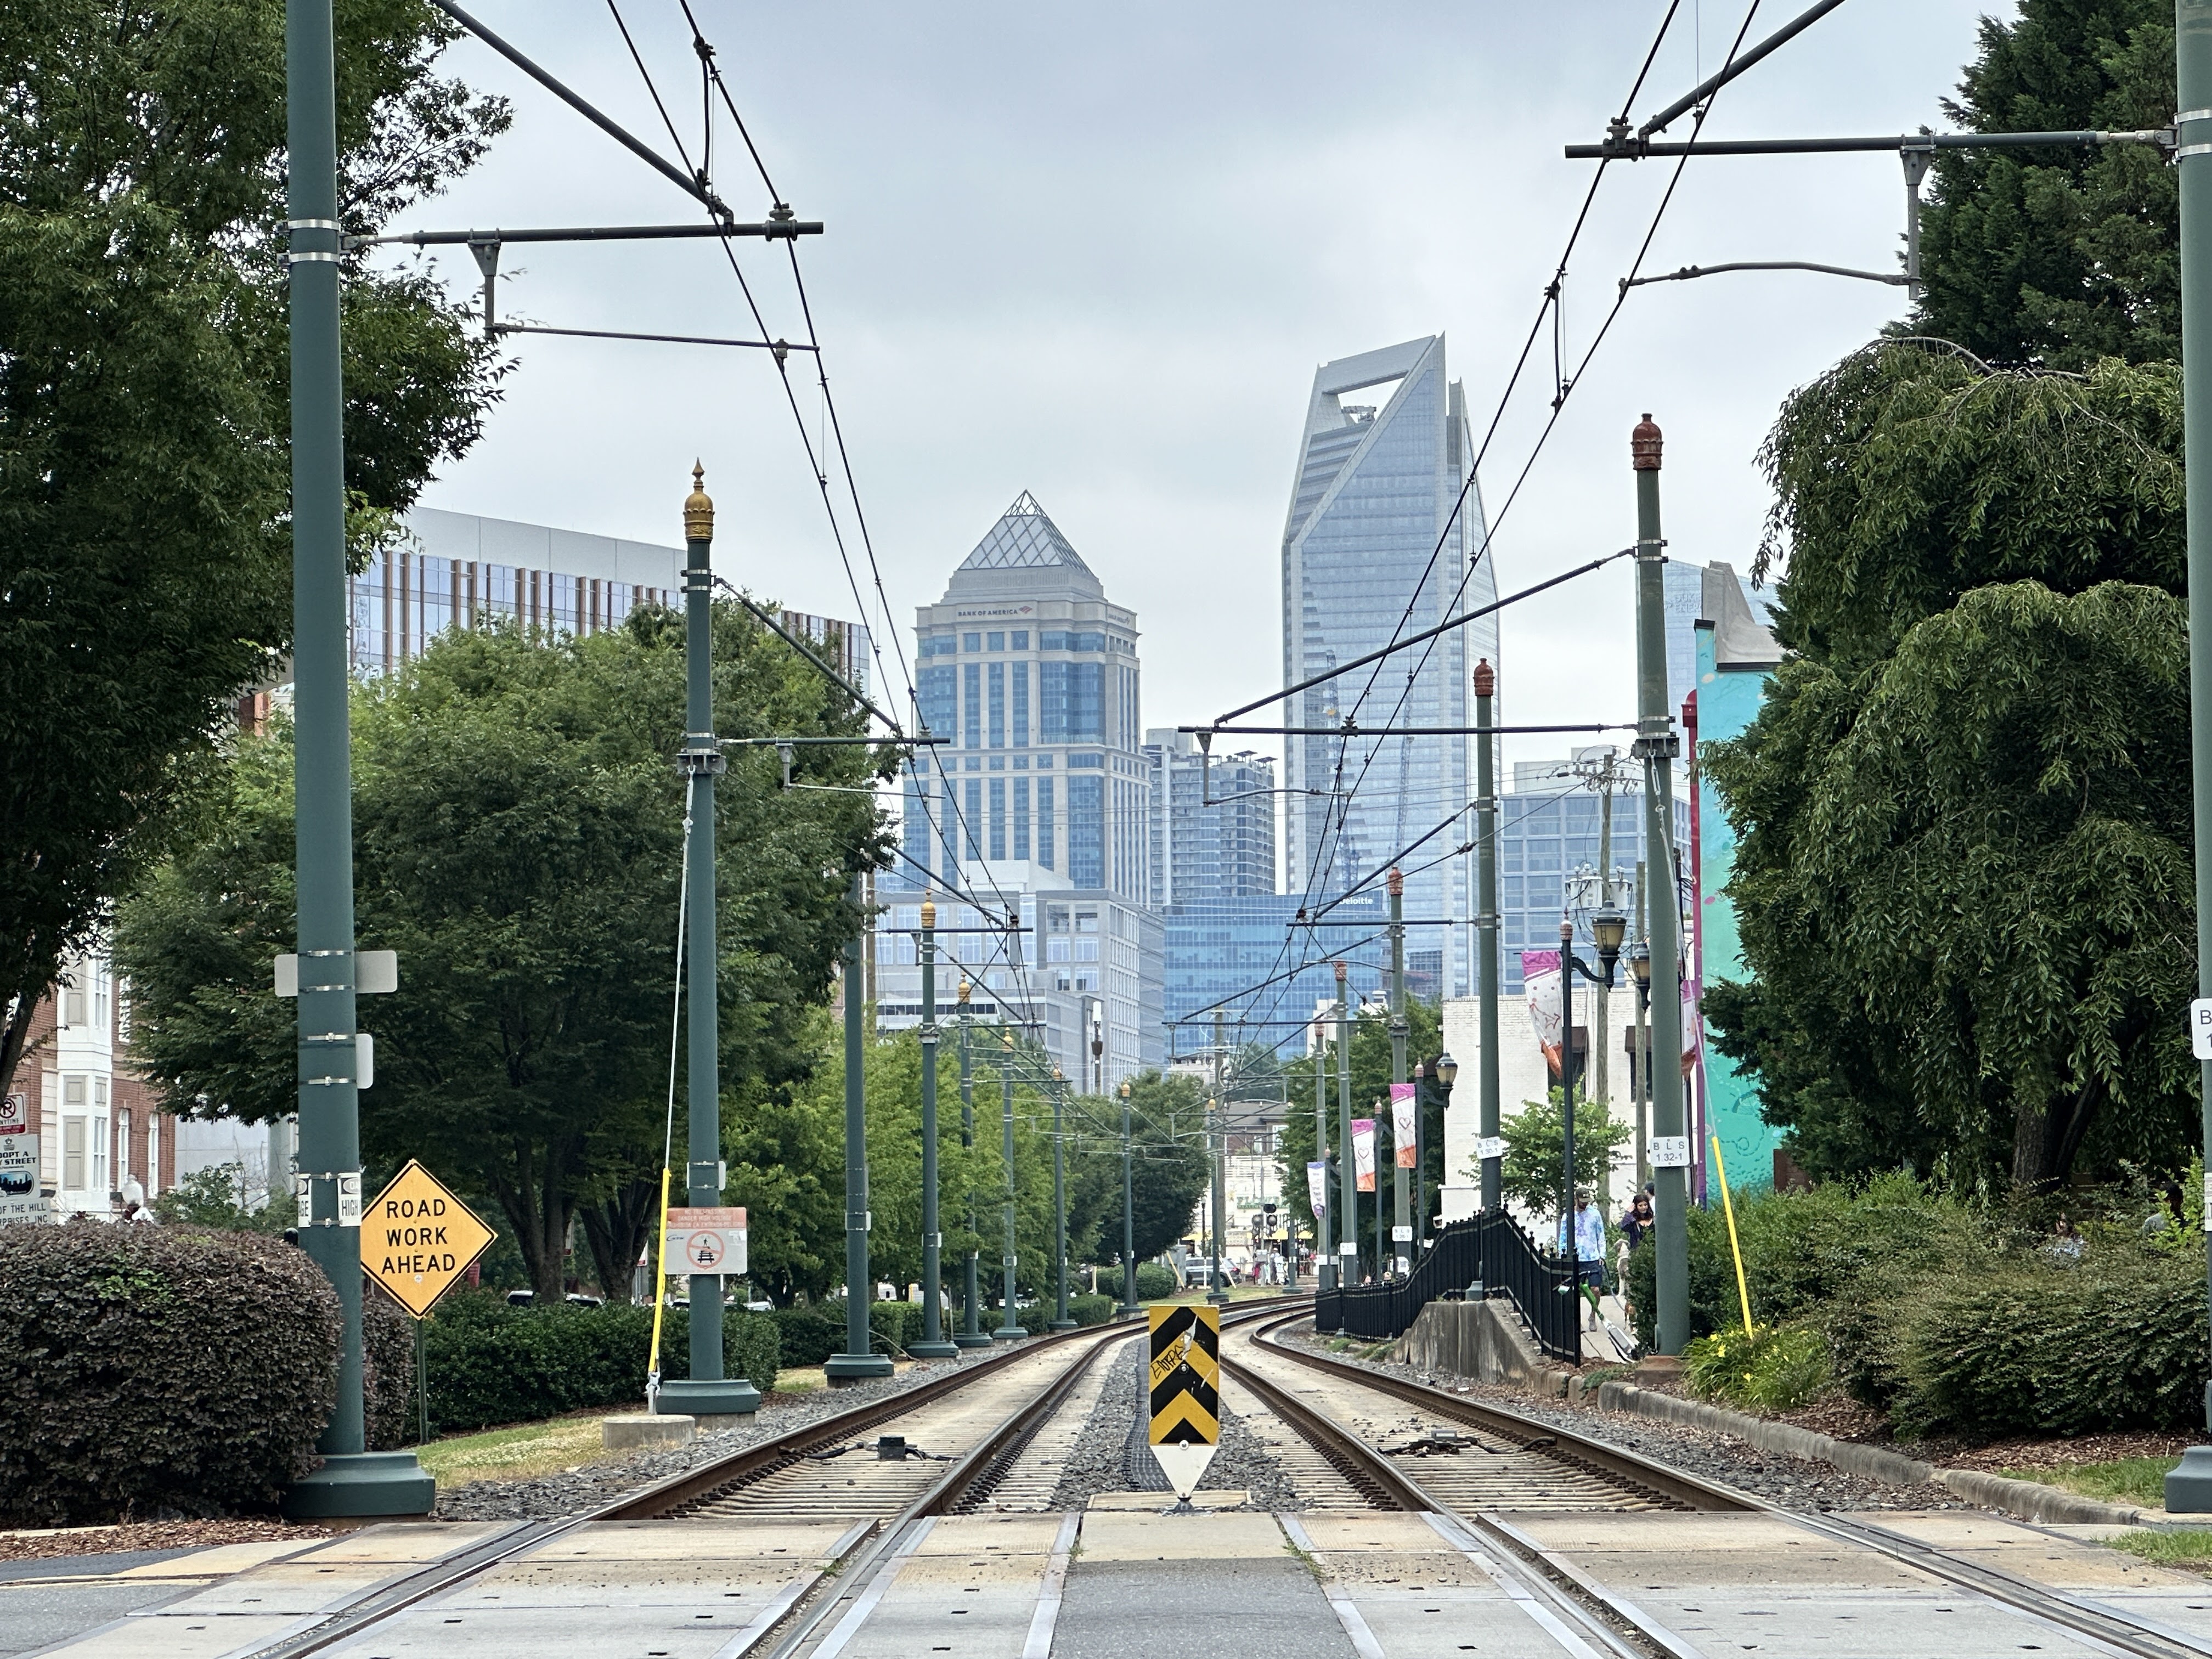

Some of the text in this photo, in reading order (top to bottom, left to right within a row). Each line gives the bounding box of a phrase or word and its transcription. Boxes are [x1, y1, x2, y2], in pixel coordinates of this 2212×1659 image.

[2200, 1009, 2212, 1025] B
[1653, 1141, 1685, 1150] B L S
[4, 1157, 37, 1165] STREET
[11, 1204, 25, 1214] THE
[29, 1203, 46, 1212] HILL
[341, 1199, 359, 1216] HIGH
[386, 1199, 446, 1218] ROAD
[35, 1214, 48, 1223] INC
[386, 1227, 448, 1247] WORK
[381, 1254, 455, 1274] AHEAD
